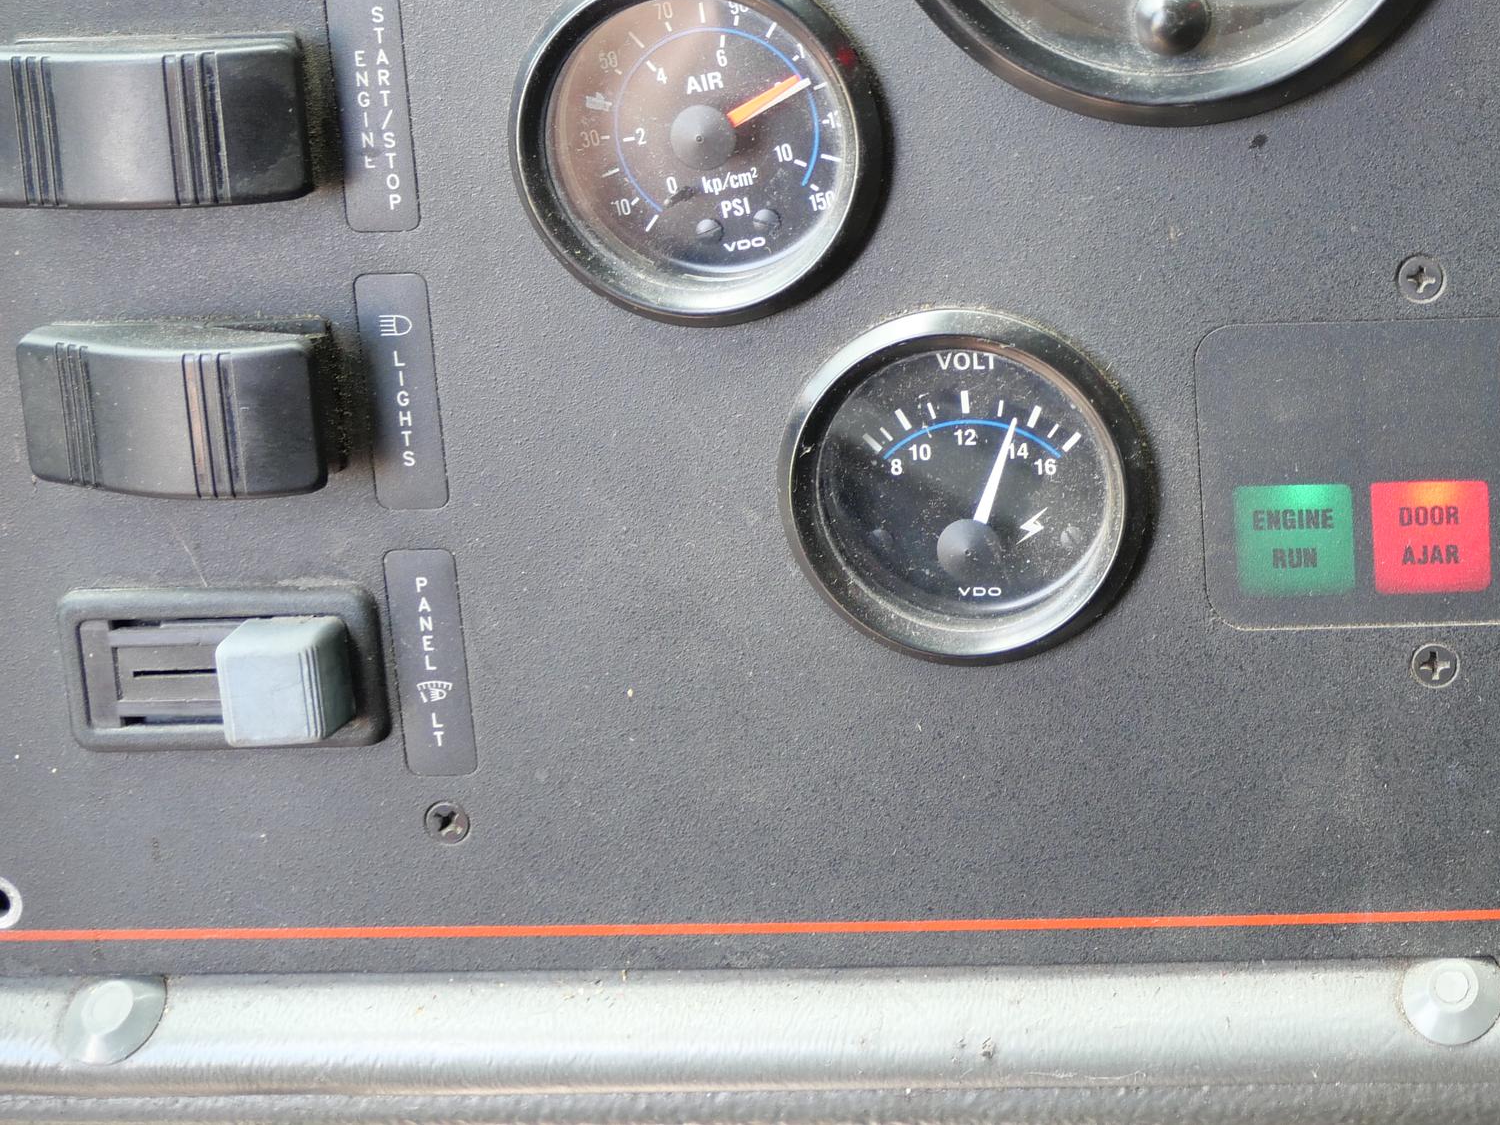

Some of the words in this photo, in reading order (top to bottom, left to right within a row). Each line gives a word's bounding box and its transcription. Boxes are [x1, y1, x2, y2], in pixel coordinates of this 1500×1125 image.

[654, 2, 673, 20] 70
[715, 49, 728, 67] 6
[656, 67, 668, 84] 4
[686, 71, 724, 95] AIR
[355, 50, 376, 170] ENGINE
[371, 6, 401, 211] START/STOP
[580, 129, 600, 148] 30
[635, 128, 647, 145] 2
[774, 143, 793, 163] 10
[666, 176, 678, 194] 0
[613, 198, 631, 216] 10
[720, 197, 751, 219] PSI
[723, 236, 766, 252] VDO
[937, 353, 995, 370] VOLT
[393, 350, 416, 467] LIGHTS
[954, 429, 977, 446] 12
[909, 443, 931, 460] 10
[1007, 442, 1028, 460] 14
[890, 459, 903, 475] 8
[1034, 458, 1056, 475] 16
[1252, 508, 1334, 531] ENGINE
[1399, 505, 1459, 526] DOOR
[1272, 547, 1317, 569] RUN
[1401, 544, 1460, 565] AJAR
[958, 587, 1002, 597] VDO
[415, 577, 436, 671] PANEL
[431, 712, 444, 748] LT
